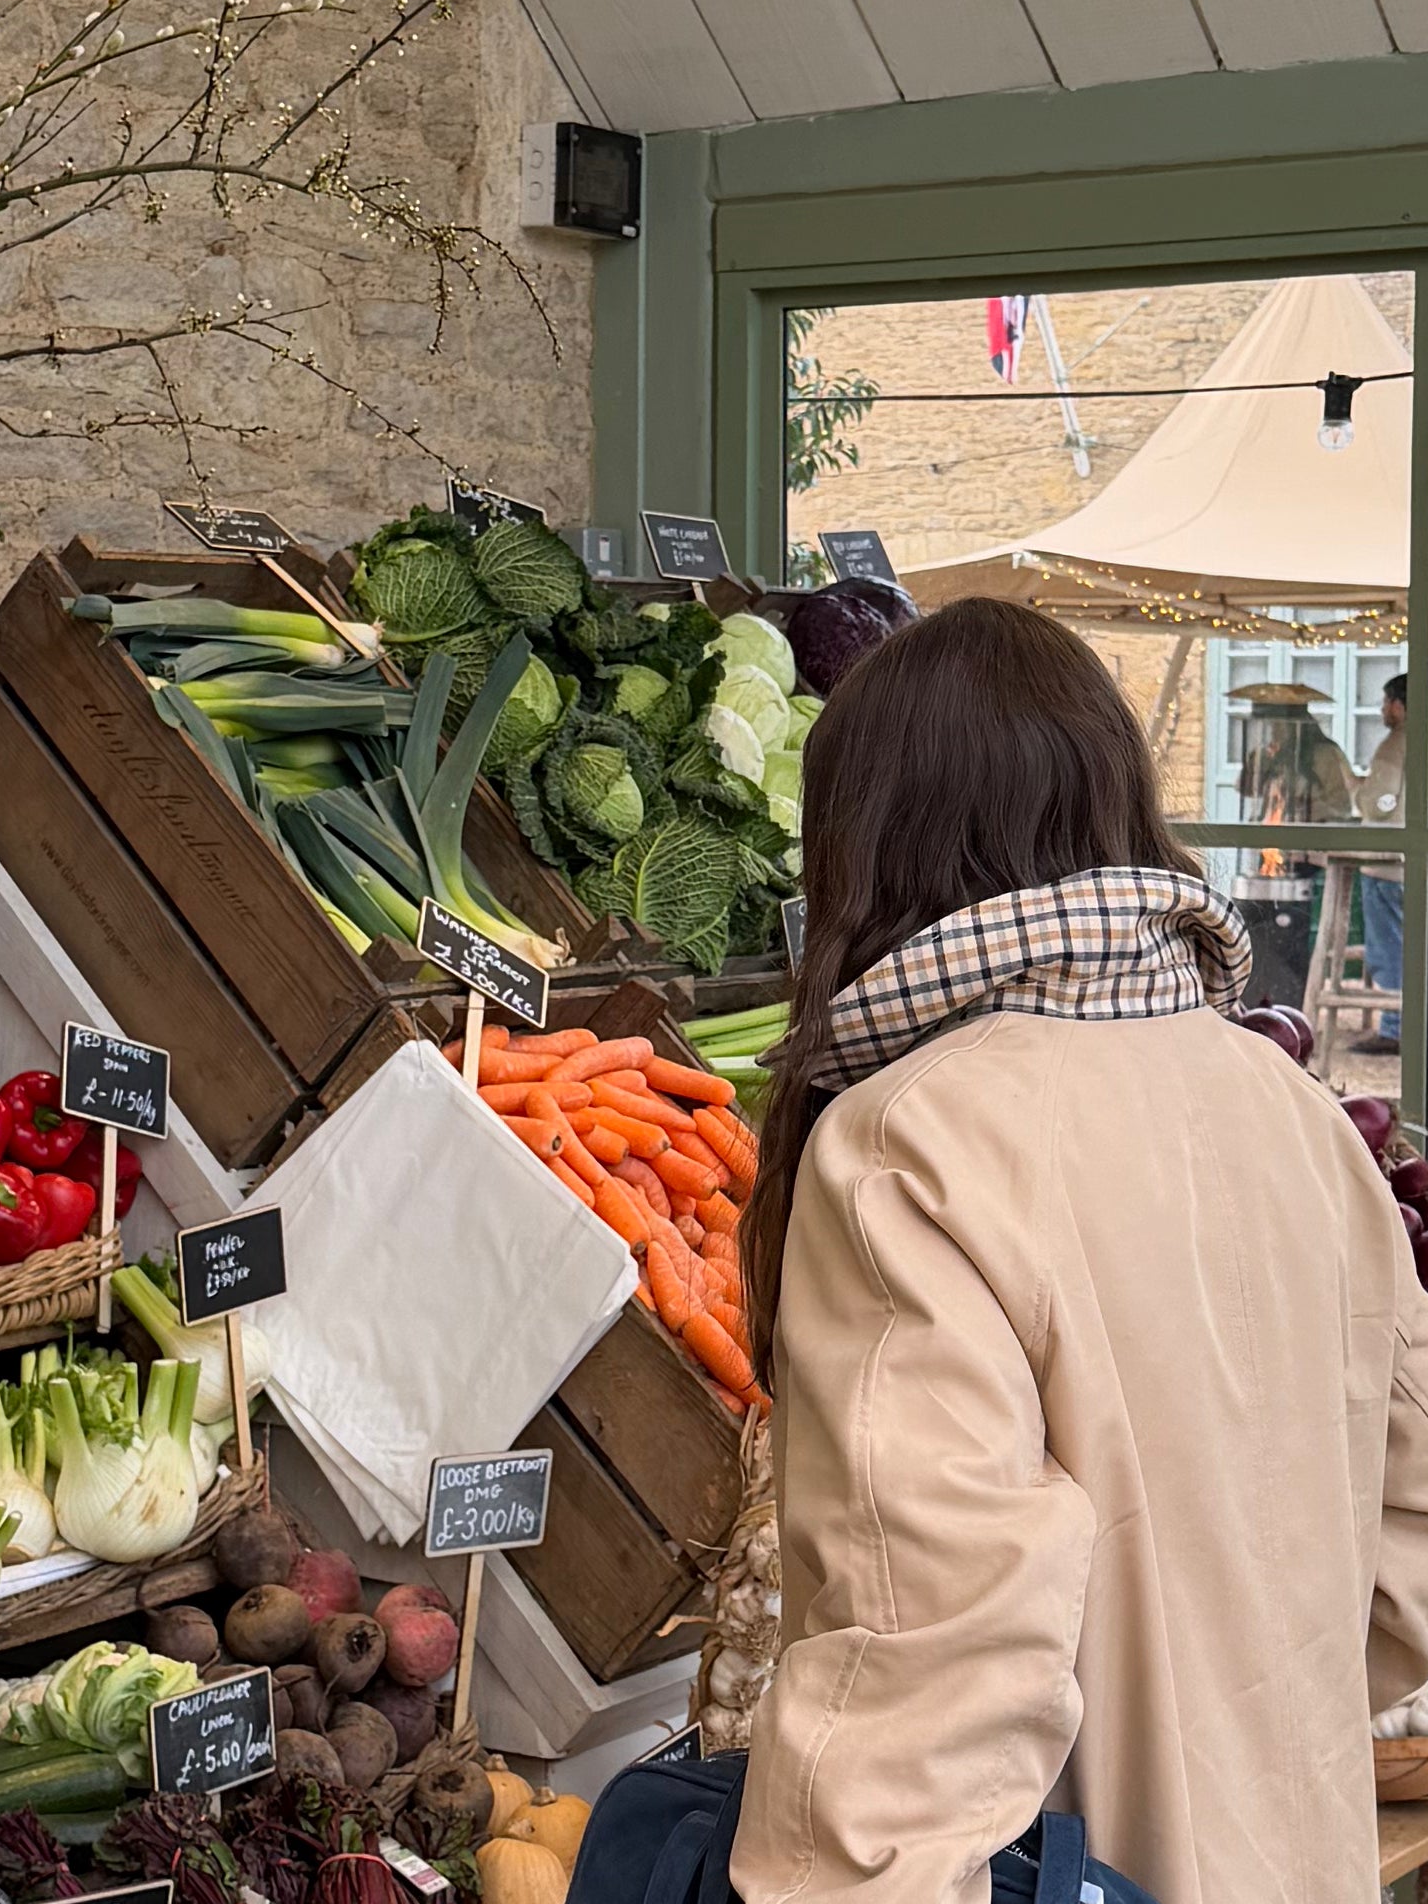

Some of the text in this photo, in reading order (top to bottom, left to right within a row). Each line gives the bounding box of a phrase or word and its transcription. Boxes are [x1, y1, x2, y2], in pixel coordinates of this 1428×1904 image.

[74, 1028, 101, 1048] RED
[439, 1457, 549, 1491] LOOSE BEETROOT
